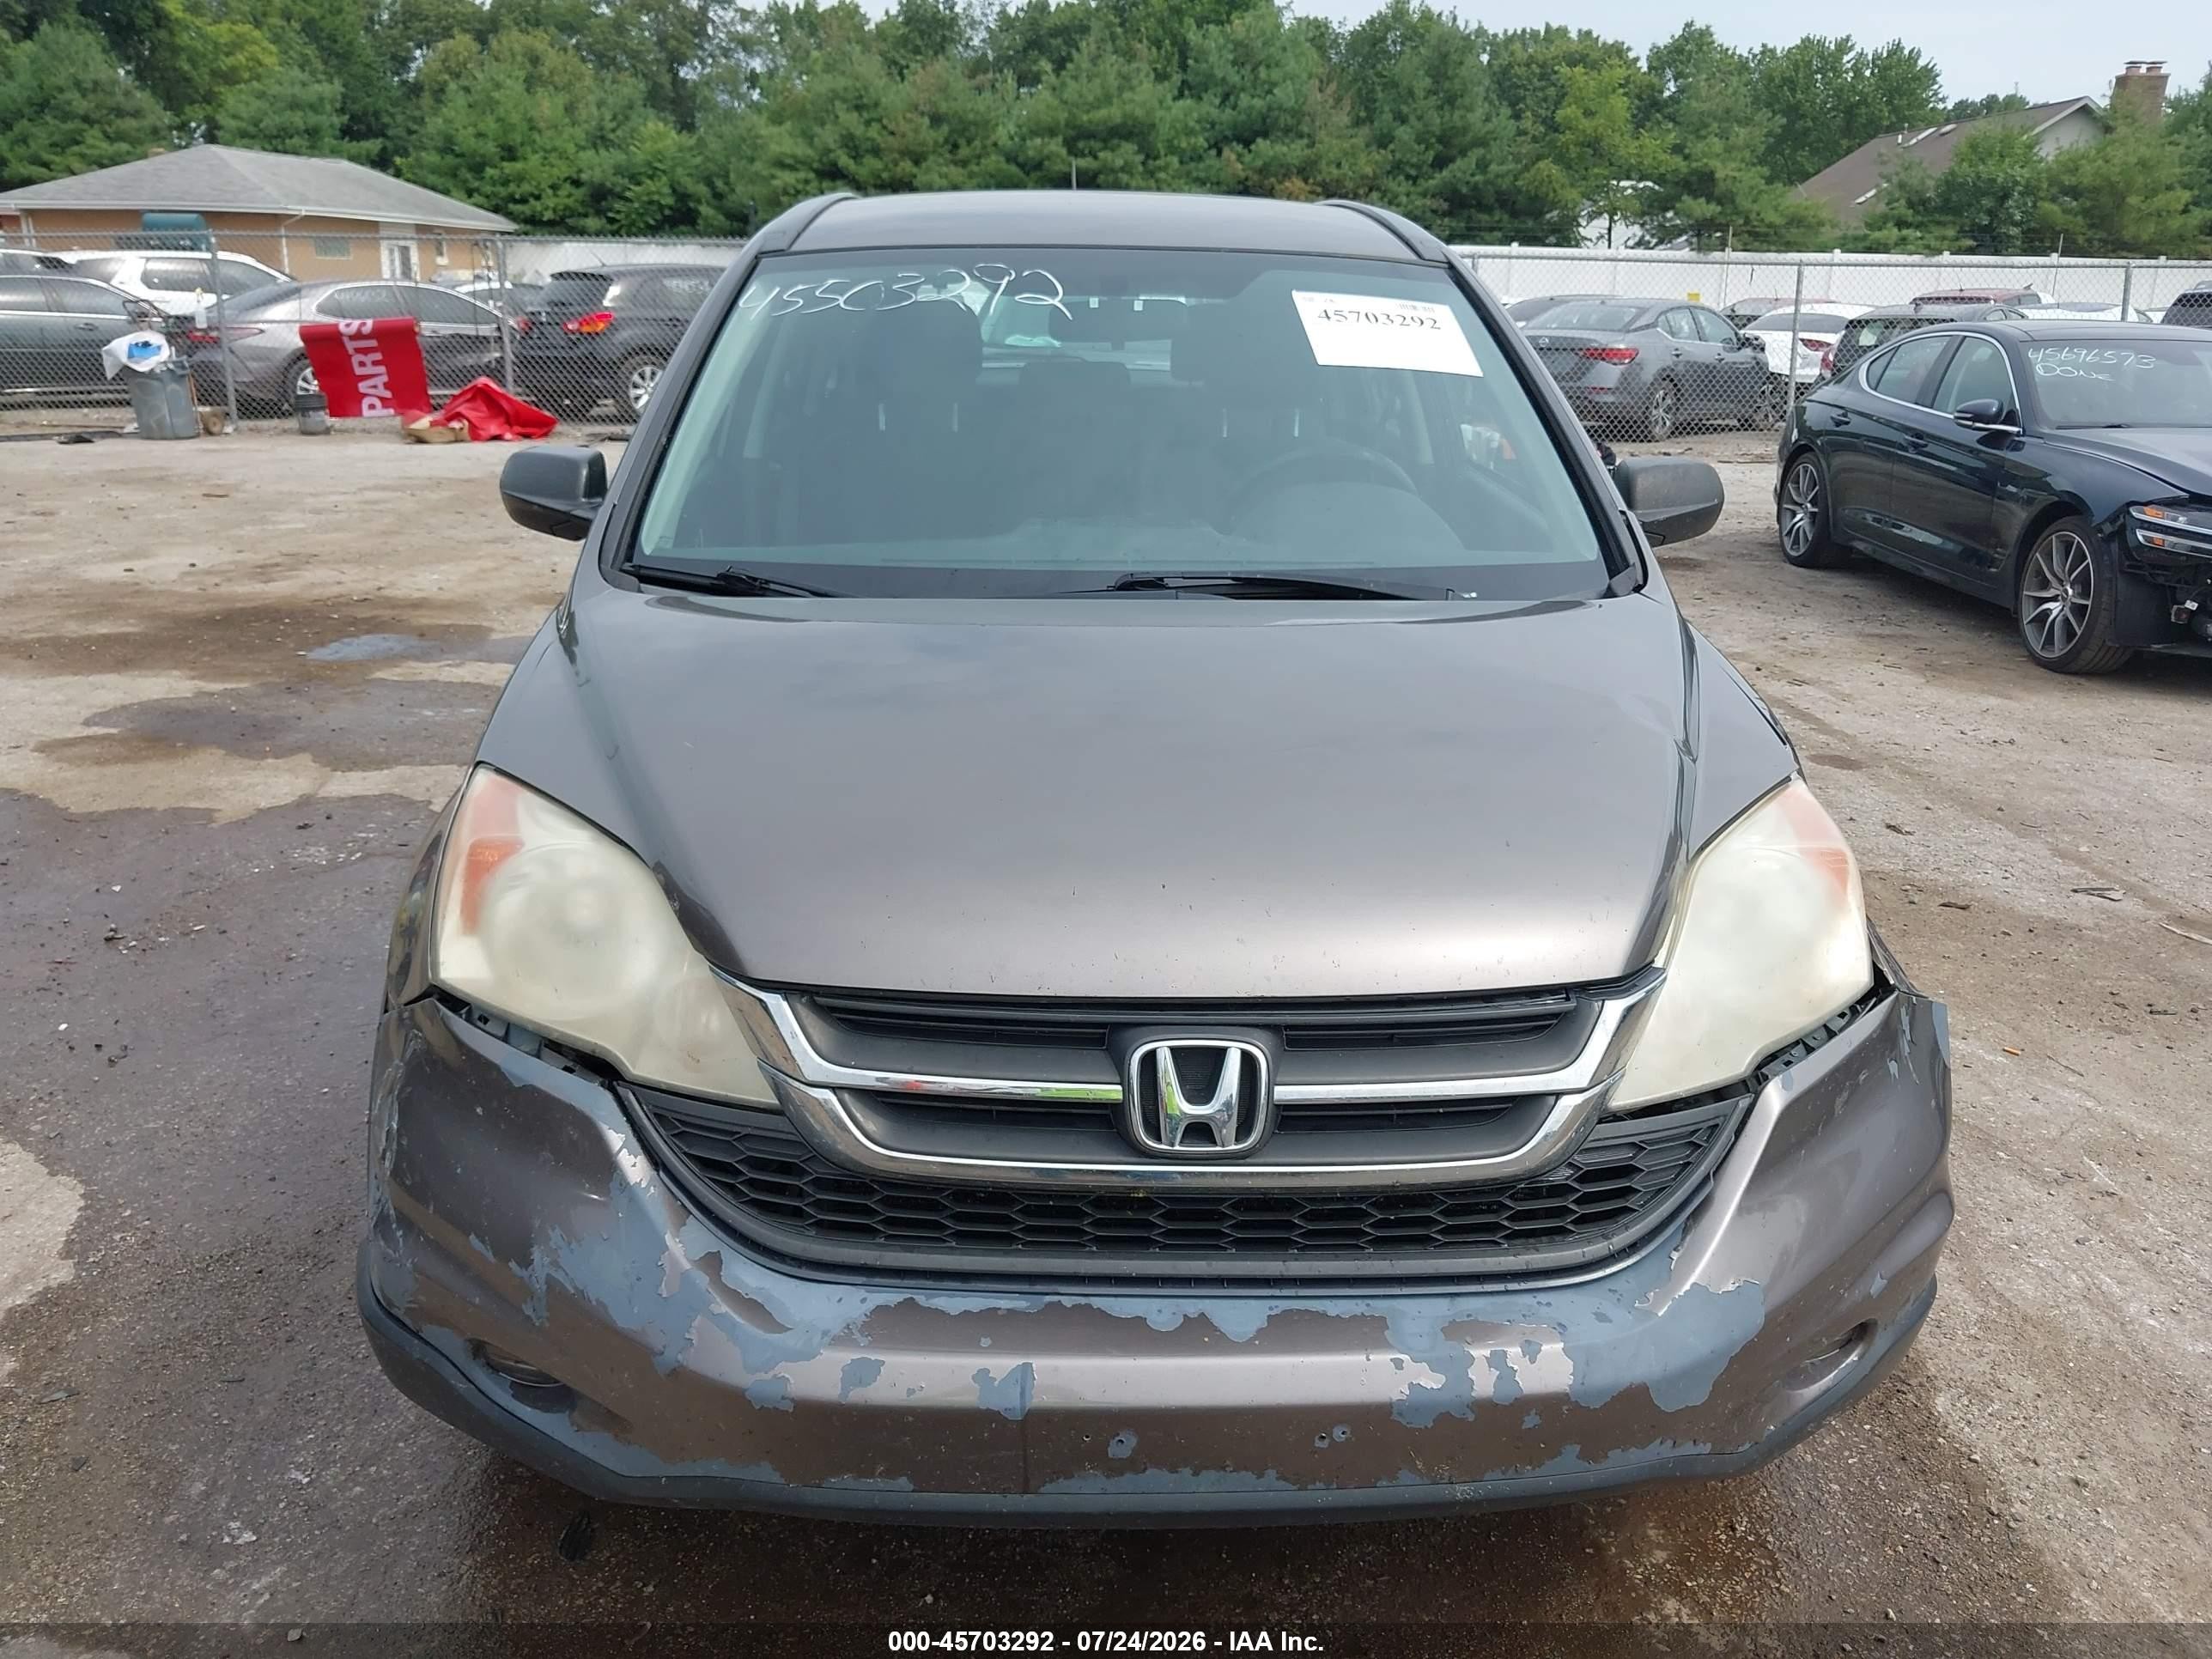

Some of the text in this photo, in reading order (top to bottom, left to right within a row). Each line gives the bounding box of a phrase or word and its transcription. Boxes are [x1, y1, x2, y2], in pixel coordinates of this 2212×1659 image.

[1317, 309, 1442, 330] 45703292
[338, 319, 395, 417] PARTS
[2027, 346, 2156, 369] 45696573
